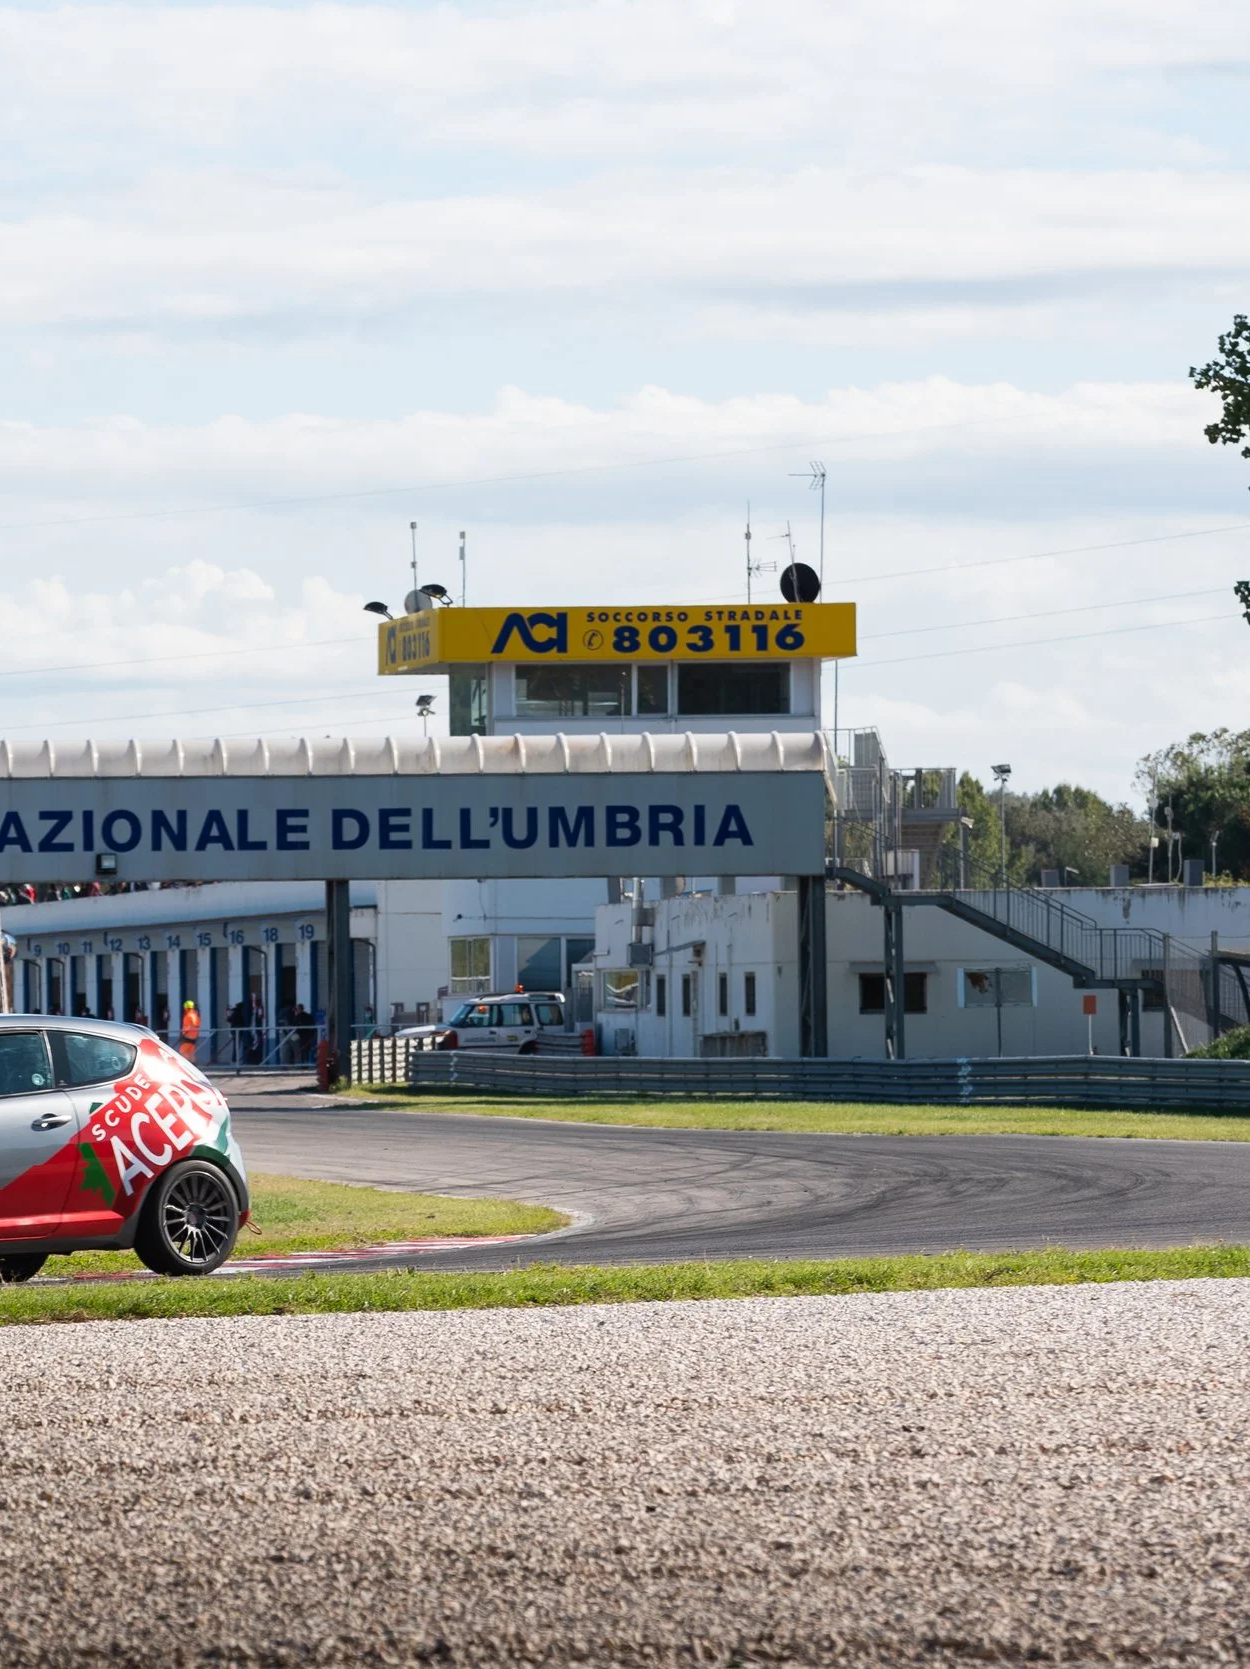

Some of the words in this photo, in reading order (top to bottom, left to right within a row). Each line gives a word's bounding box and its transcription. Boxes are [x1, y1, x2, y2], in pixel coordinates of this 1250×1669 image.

[586, 611, 689, 623] SOCCORSO
[704, 609, 803, 622] STRADALE
[491, 612, 568, 654] ACI
[612, 623, 805, 654] 803116
[332, 804, 754, 851] DELL'UMBRIA
[229, 930, 245, 944] 16
[263, 927, 279, 942] 18
[298, 924, 315, 940] 19
[110, 938, 123, 952] 12
[138, 935, 151, 951] 13
[166, 935, 181, 949] 14
[197, 932, 212, 947] 15
[33, 944, 42, 957] 9
[56, 942, 70, 956] 10
[82, 941, 93, 953] 11
